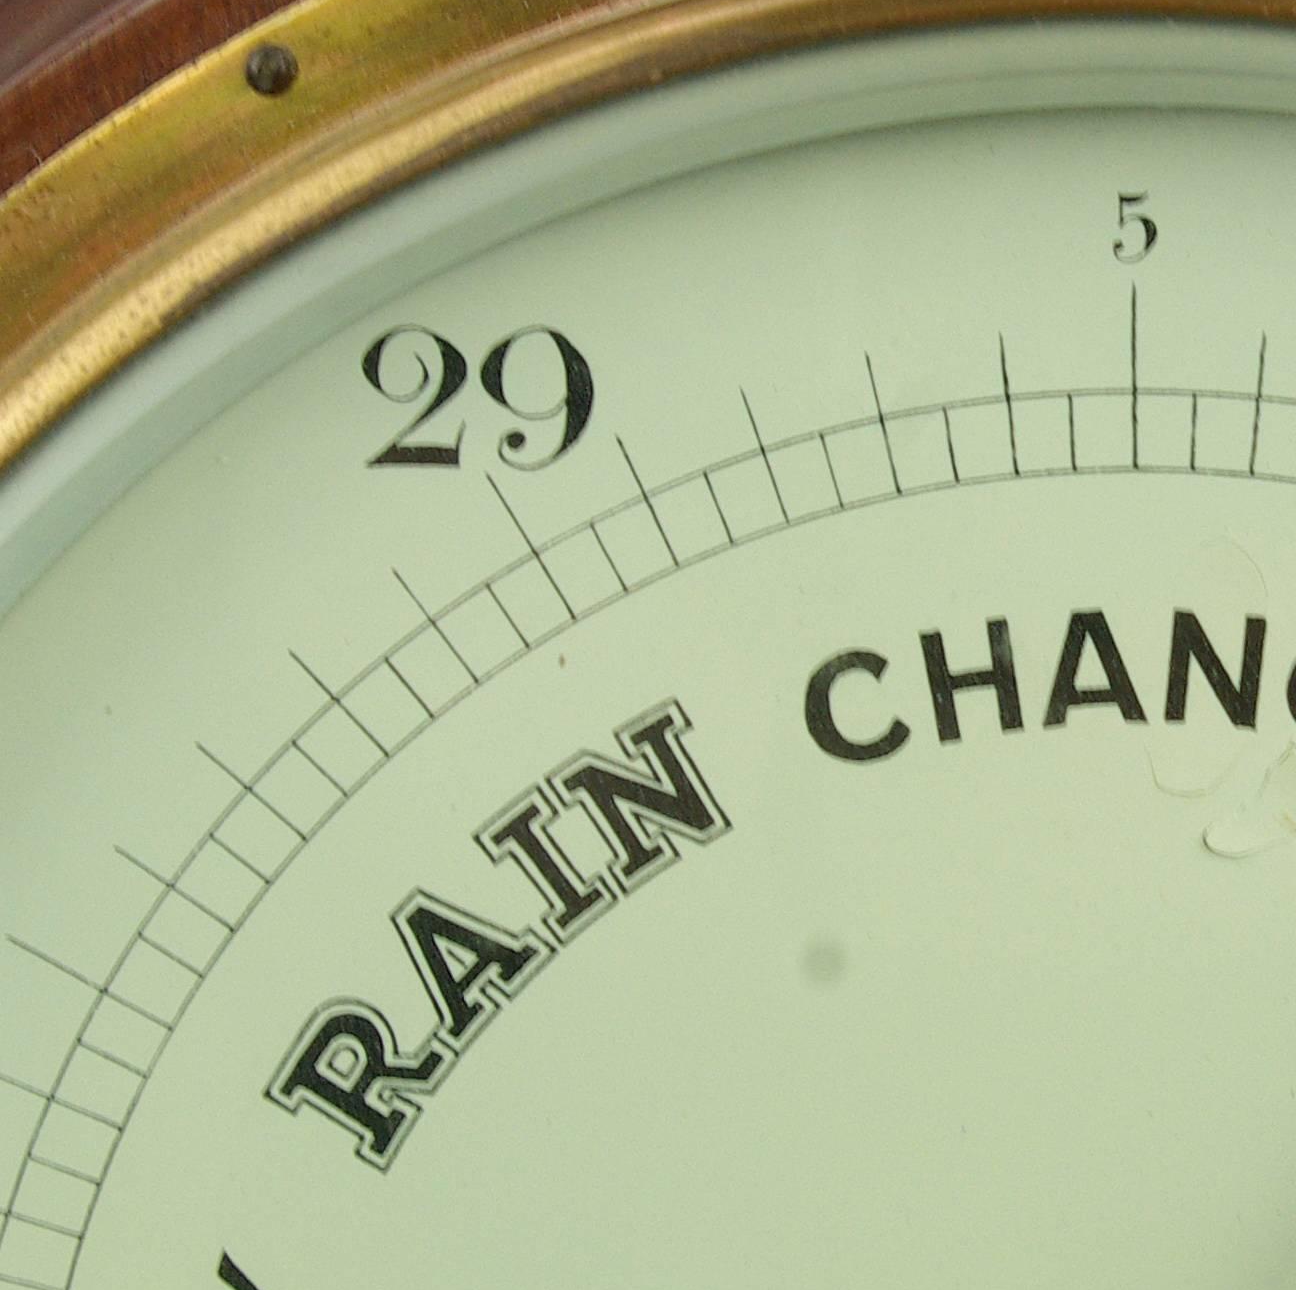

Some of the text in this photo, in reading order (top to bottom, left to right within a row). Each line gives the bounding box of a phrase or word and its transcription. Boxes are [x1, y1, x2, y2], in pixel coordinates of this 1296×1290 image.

[1110, 189, 1159, 265] 5
[358, 321, 597, 471] 29
[262, 697, 733, 1172] RAIN
